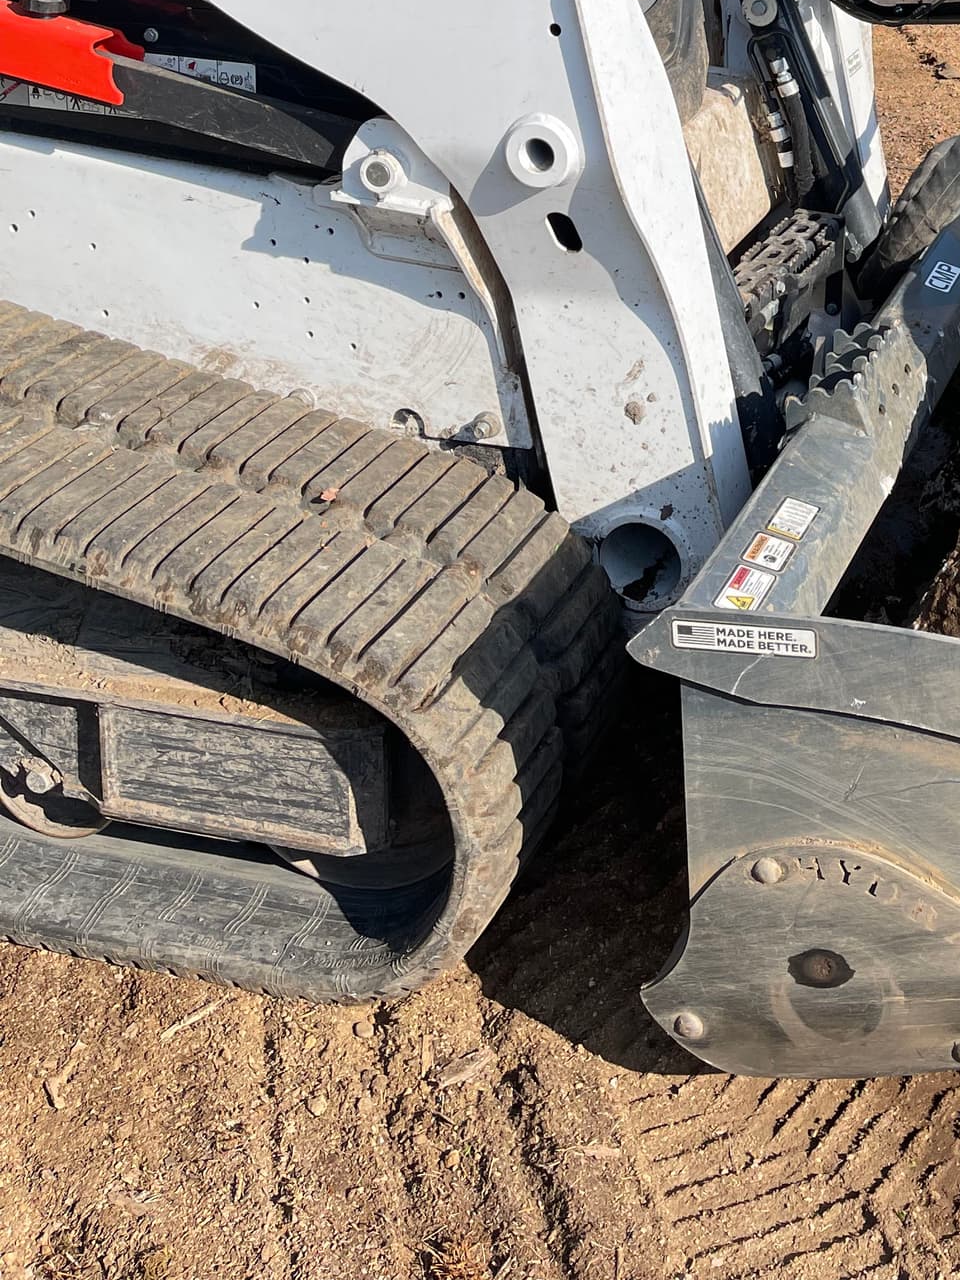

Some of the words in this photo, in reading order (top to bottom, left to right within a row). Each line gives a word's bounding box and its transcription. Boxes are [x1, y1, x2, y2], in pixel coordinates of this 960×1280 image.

[928, 263, 958, 290] CMP
[716, 628, 755, 639] MADE
[758, 631, 797, 642] HERE.
[716, 638, 755, 649] MADE
[758, 642, 812, 654] BETTER.
